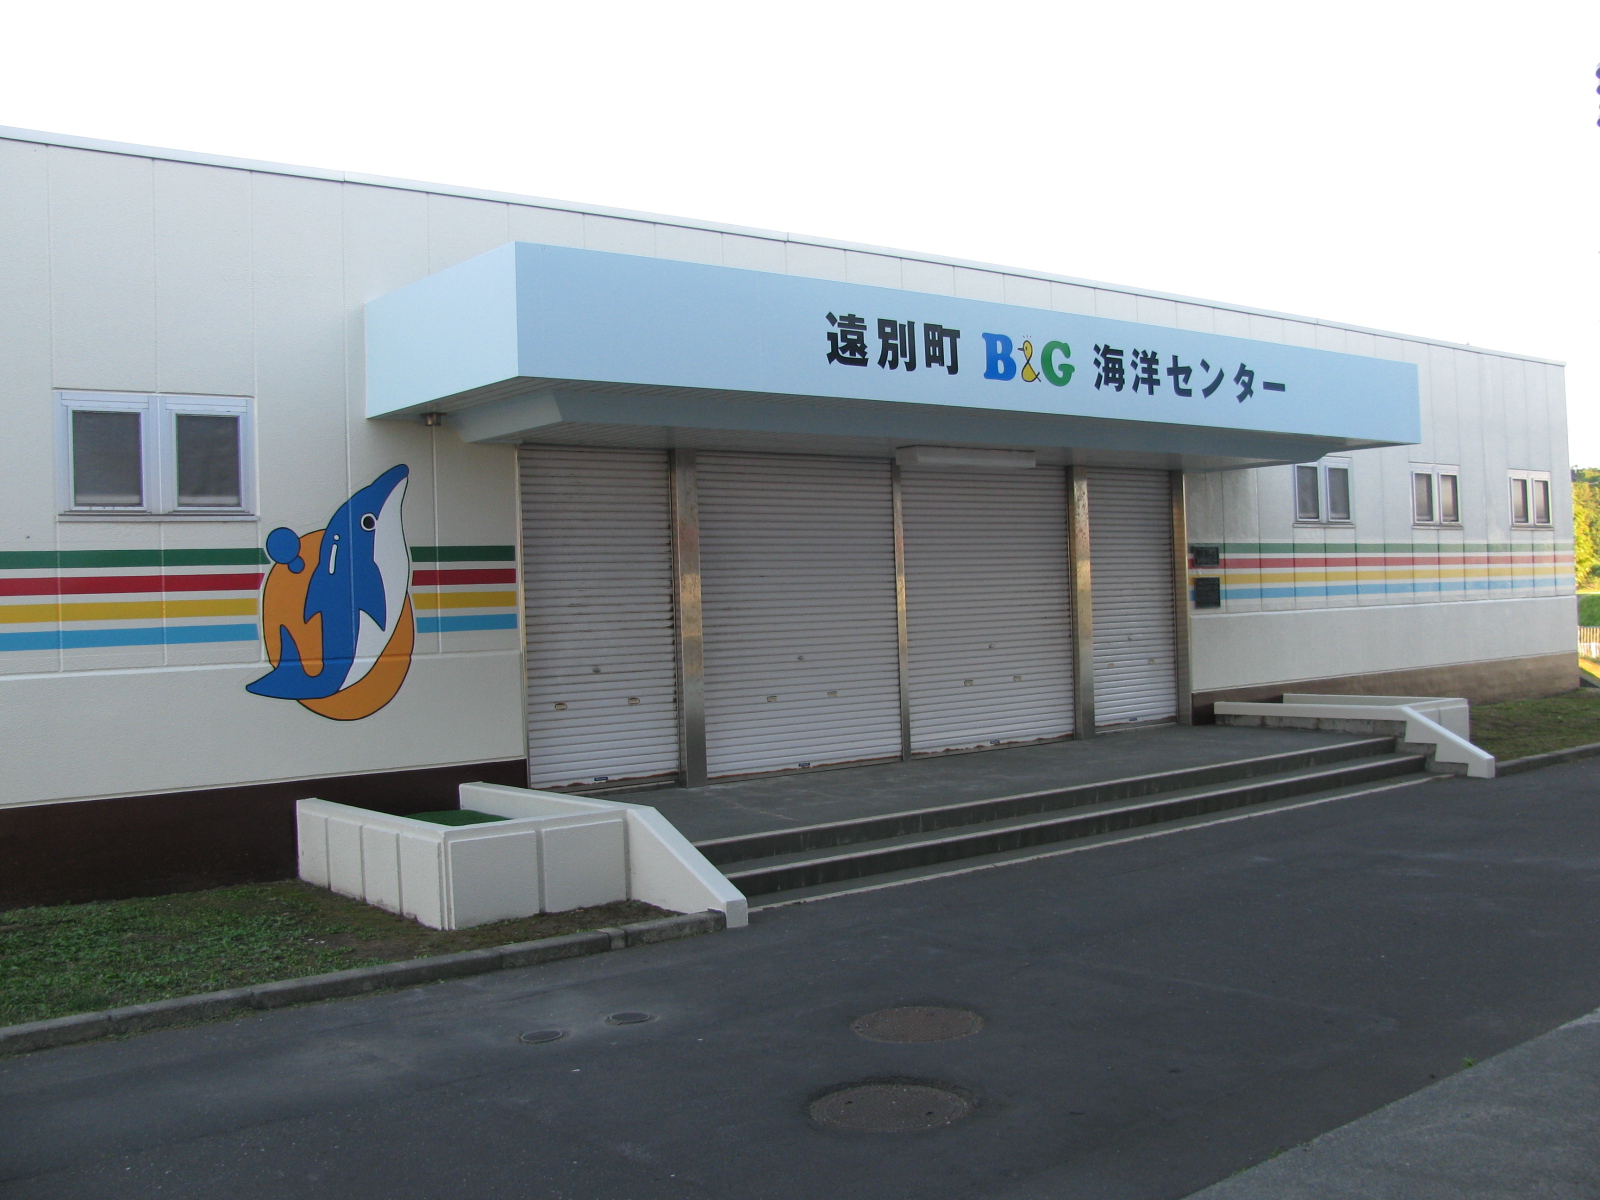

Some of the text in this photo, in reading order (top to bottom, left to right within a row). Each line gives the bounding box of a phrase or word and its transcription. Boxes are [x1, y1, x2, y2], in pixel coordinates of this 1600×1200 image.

[825, 311, 1286, 403] 遠別町 B&G 海洋センター
